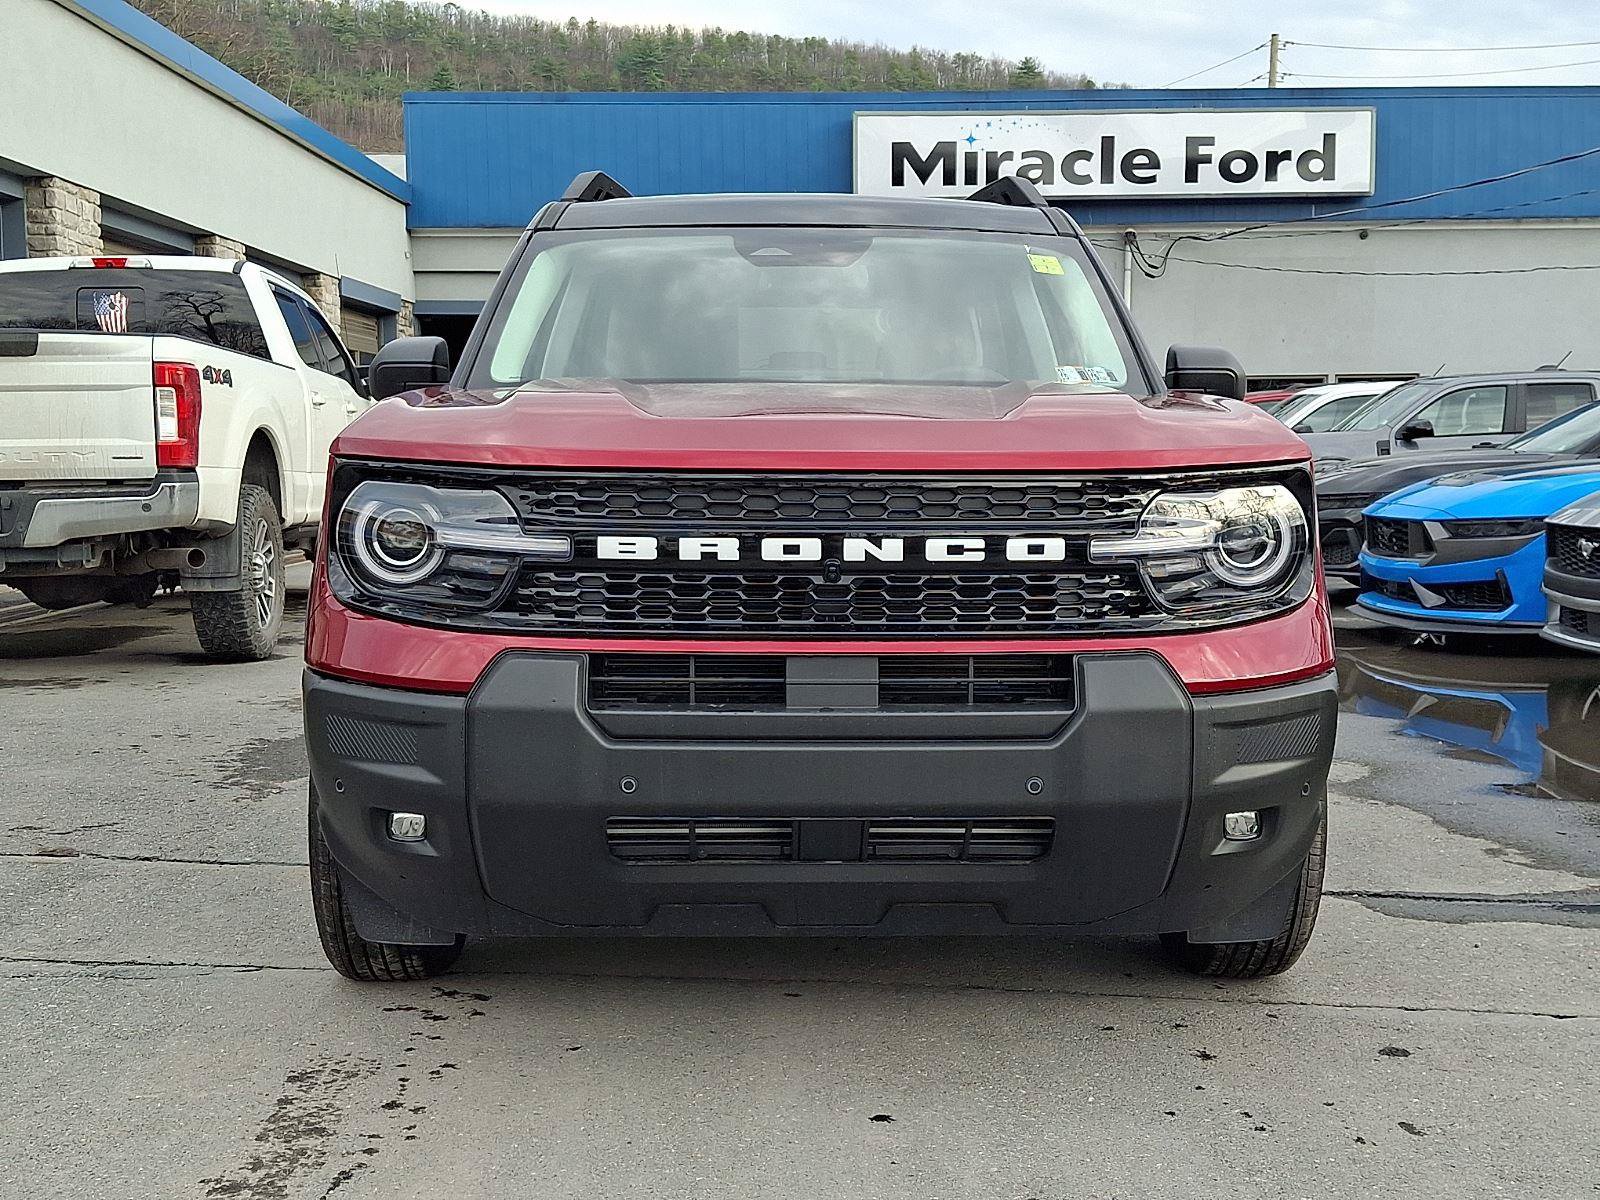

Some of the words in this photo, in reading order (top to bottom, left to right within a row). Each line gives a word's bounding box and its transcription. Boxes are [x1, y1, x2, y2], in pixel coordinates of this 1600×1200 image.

[891, 136, 1161, 187] Miracle
[1185, 133, 1336, 184] Ford
[597, 536, 1066, 561] BRONCO
